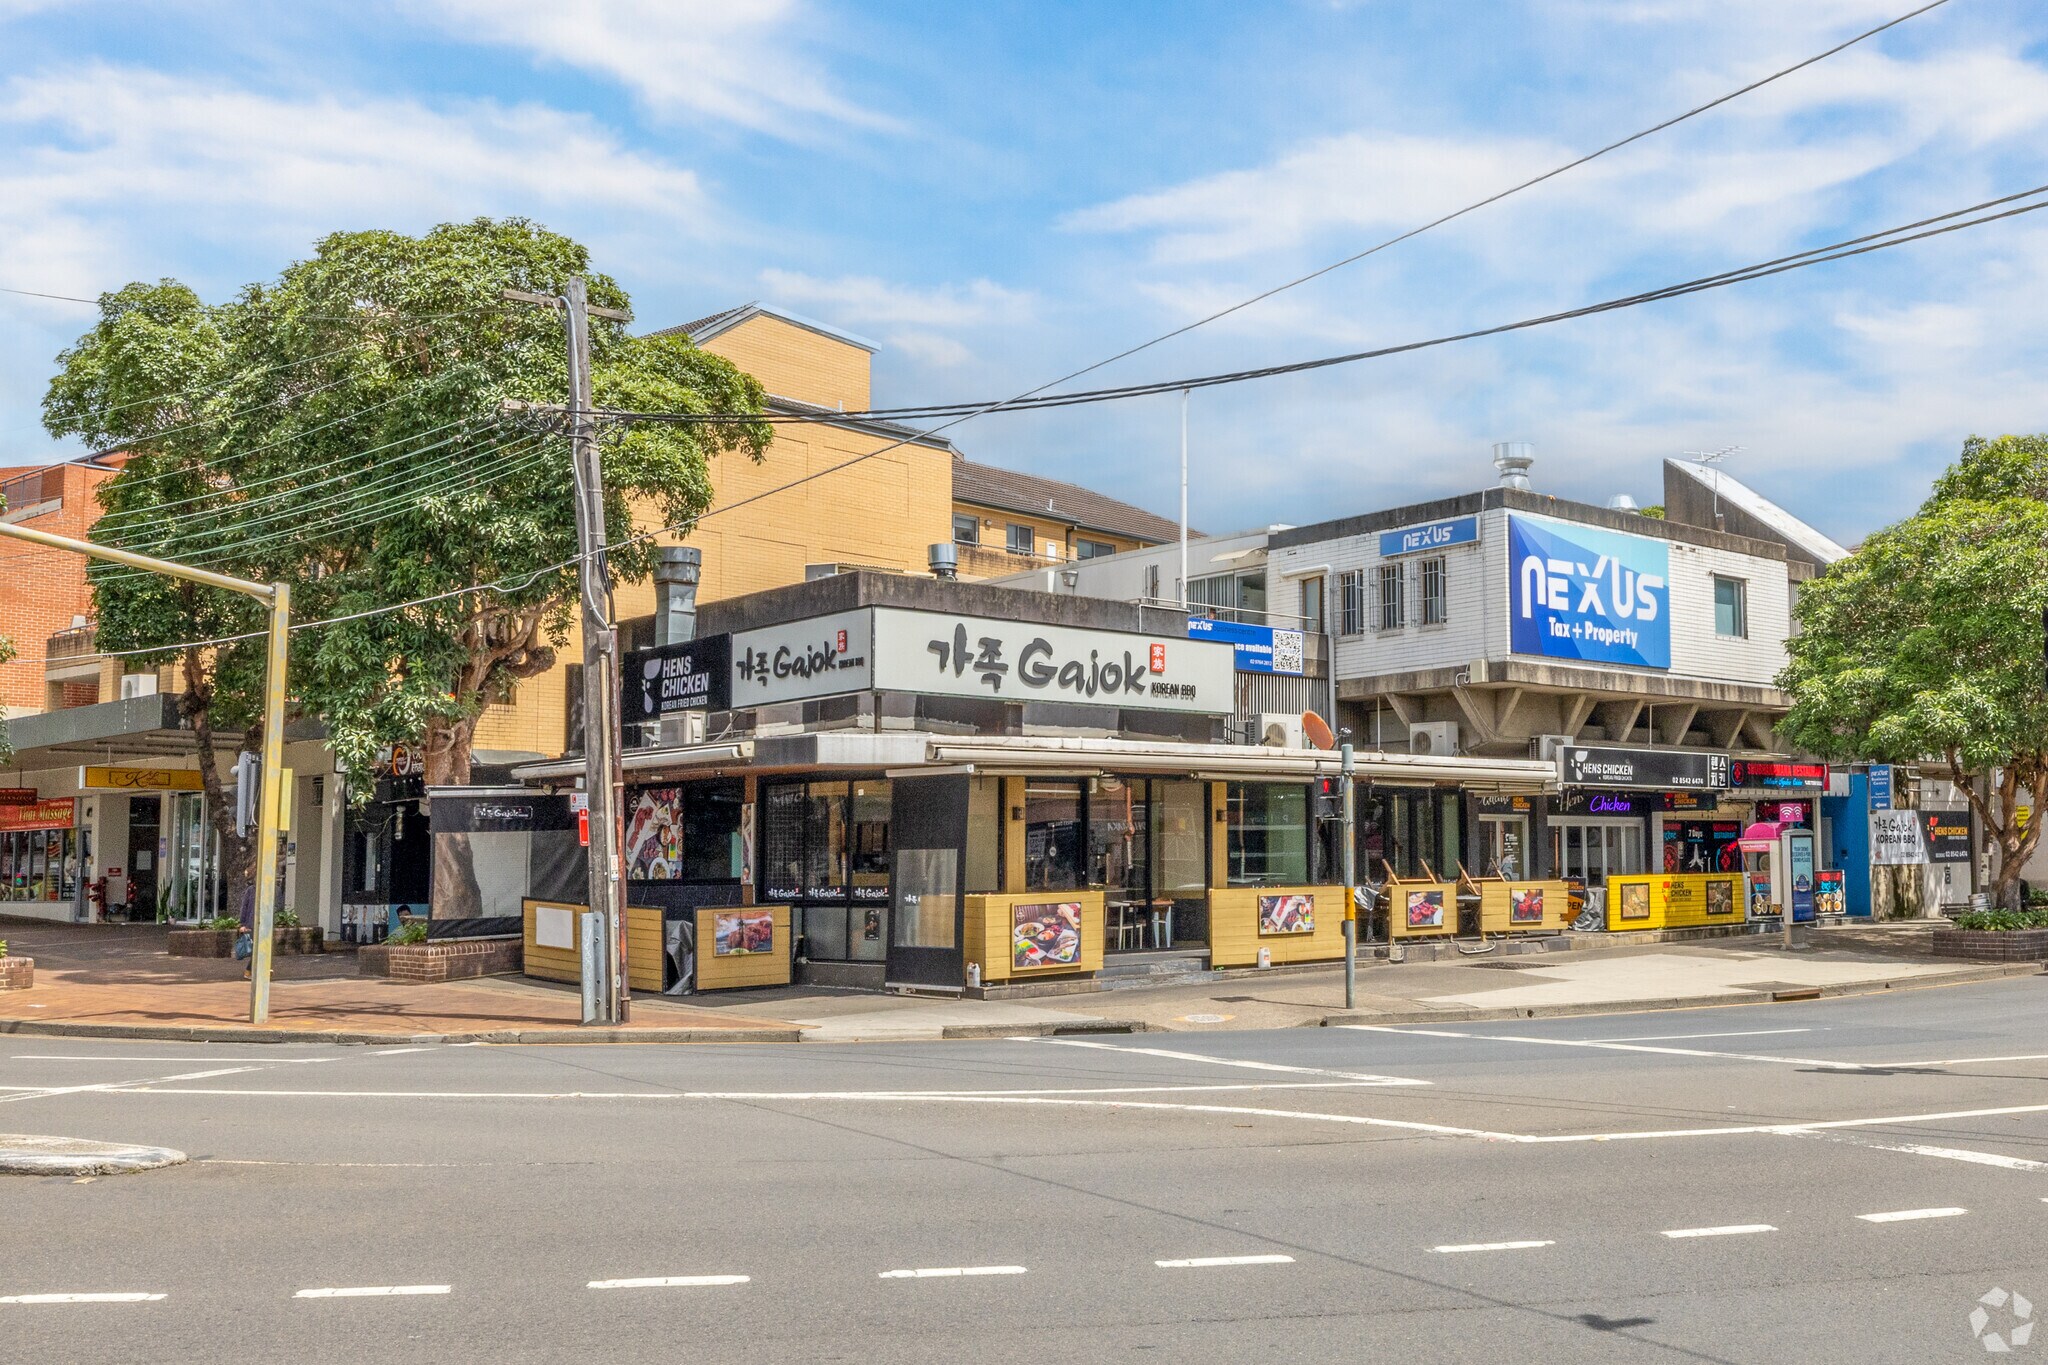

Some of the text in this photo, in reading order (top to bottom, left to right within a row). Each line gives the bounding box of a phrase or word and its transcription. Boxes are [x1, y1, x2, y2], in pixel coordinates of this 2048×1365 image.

[1214, 624, 1238, 634] business
[1549, 617, 1638, 649] Tax + Property
[1246, 644, 1272, 654] available
[736, 640, 838, 686] 가족 Gajok
[927, 622, 1147, 697] 가족 Gajok
[662, 655, 692, 678] HENS
[661, 672, 709, 698] CHICKEN
[1151, 682, 1196, 698] KOREAN BBQ
[678, 697, 690, 708] FRIED
[690, 695, 708, 707] CHICKEN
[1582, 763, 1633, 776] HENS CHICKEN
[1711, 756, 1726, 771] 헨스
[1710, 772, 1726, 787] 치킨
[1590, 795, 1630, 812] Chicken
[18, 805, 73, 824] Thai Massage
[1935, 827, 1968, 835] HENS CHICKEN
[1876, 834, 1916, 845] KOREAN BBQ
[779, 888, 796, 898] Gajok
[820, 888, 838, 898] Gajok
[866, 888, 884, 898] Gajok
[1671, 889, 1692, 897] CHICKEN
[1568, 901, 1584, 910] PEN
